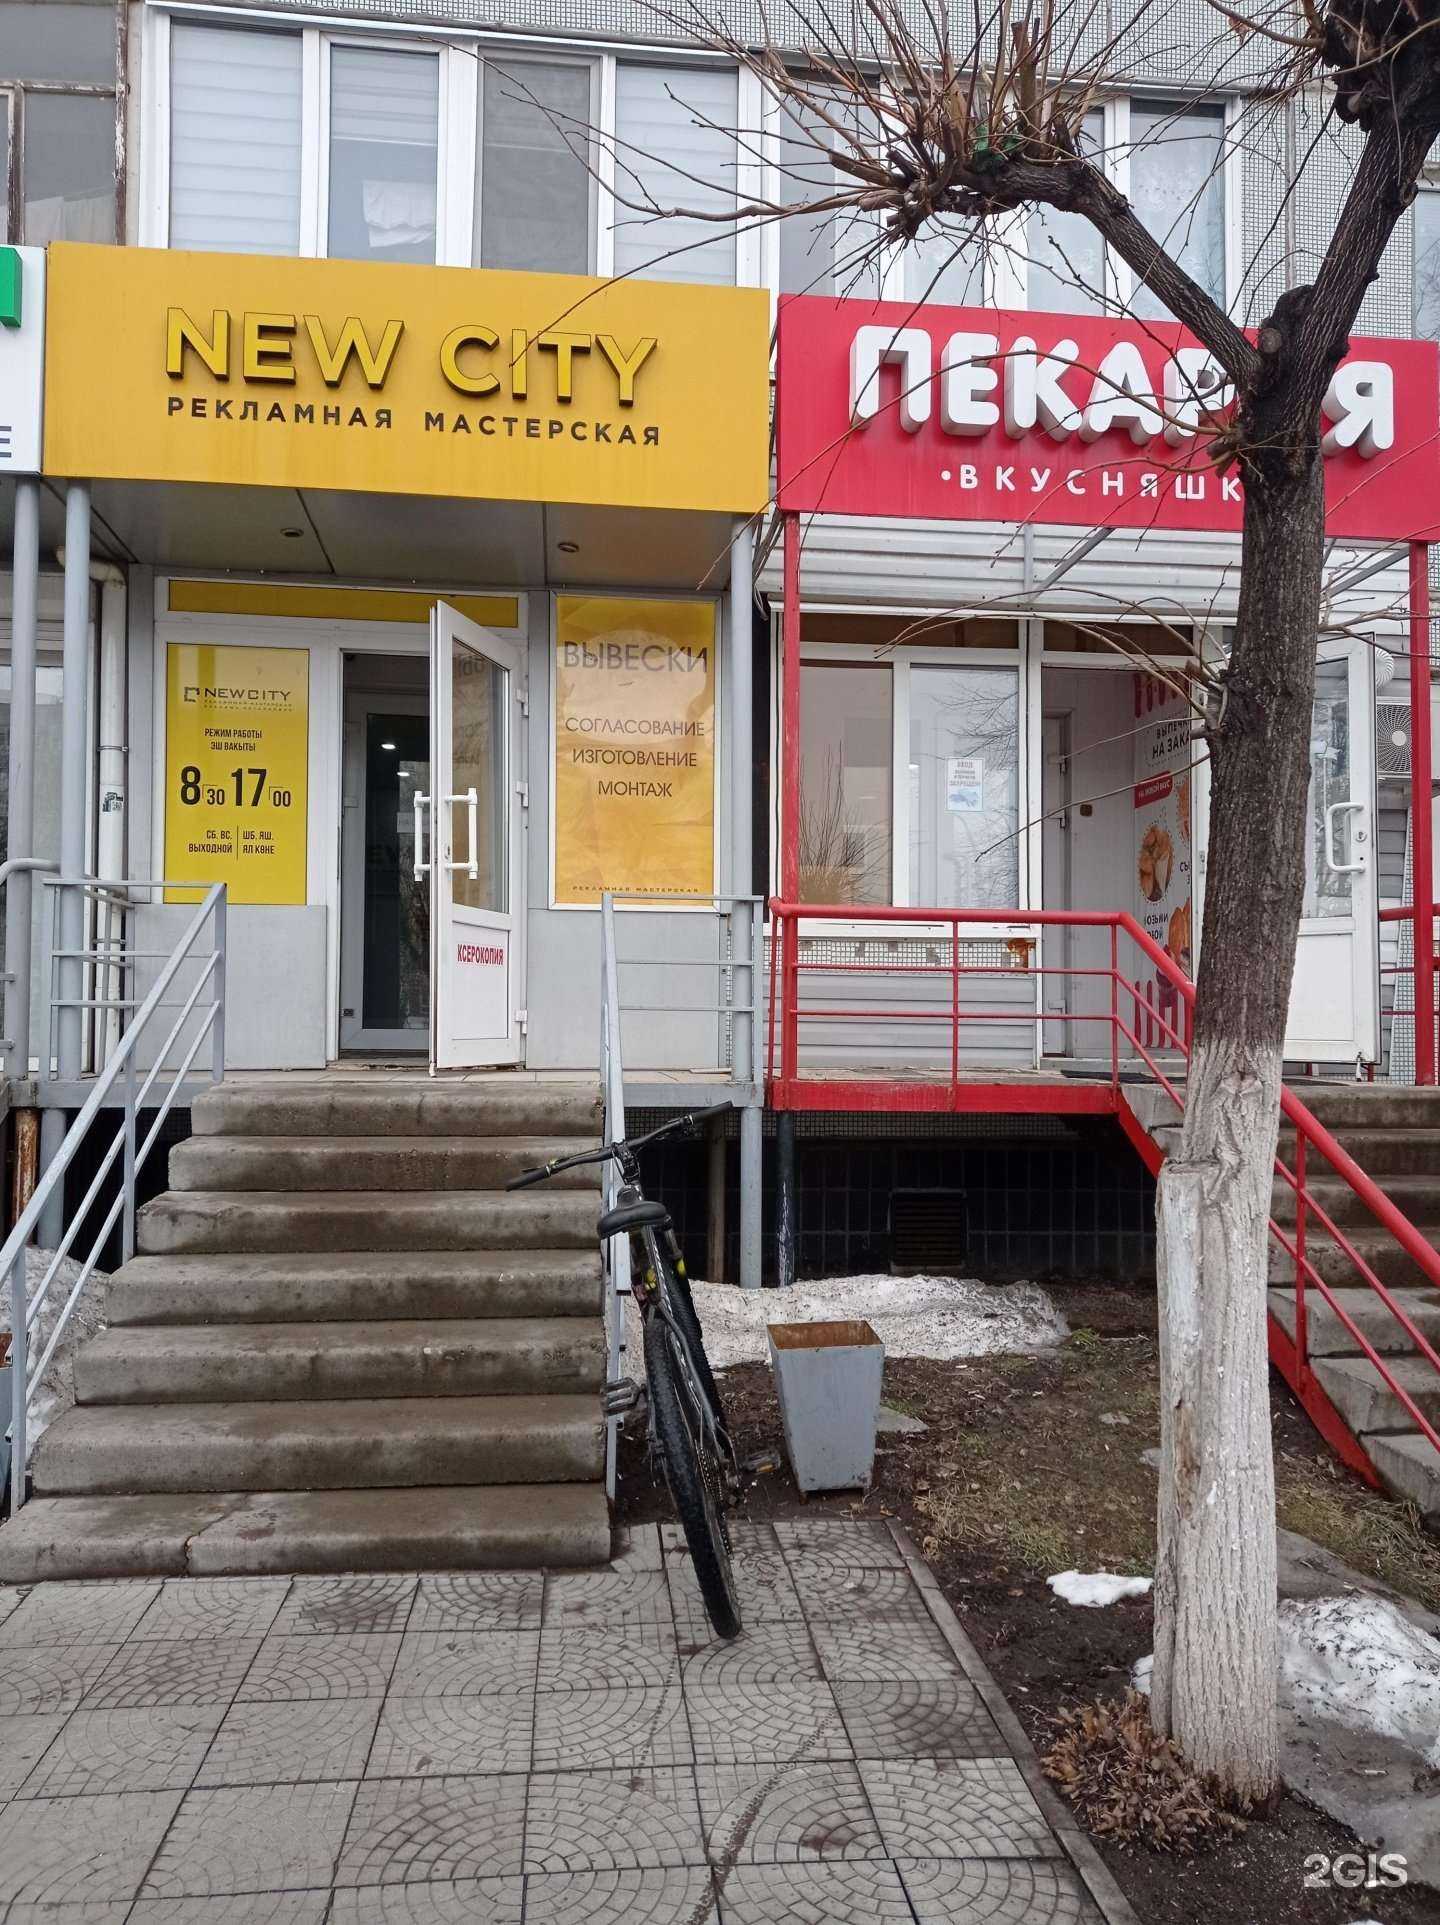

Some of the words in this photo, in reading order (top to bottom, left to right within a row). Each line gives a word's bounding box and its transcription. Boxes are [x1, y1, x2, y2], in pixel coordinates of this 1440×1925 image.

[166, 306, 405, 390] NEW
[439, 324, 659, 407] CITY
[849, 325, 1395, 459] ПЕКАРЯ
[167, 396, 393, 430] РЕКЛАМНАЯ
[425, 412, 660, 446] МАСТЕРСКАЯ
[959, 463, 1242, 502] ВКУСНЯШК
[563, 641, 708, 674] ВЫВЕСКИ
[204, 728, 232, 738] РЕЖИМ
[233, 729, 262, 739] РАБОТЫ
[565, 716, 705, 737] СОГЛАСОВАНИЕ
[211, 741, 222, 750] ЭШ
[572, 748, 697, 767] ИЗГОТОВЛЕНИЕ
[181, 766, 201, 805] 8
[207, 788, 225, 805] 30
[231, 768, 267, 807] 17
[273, 790, 291, 807] 00
[598, 781, 673, 798] МОНТАЖ
[188, 843, 233, 853] ВЫХОДНОЙ
[457, 944, 503, 965] КСЕРОКОПИЯ
